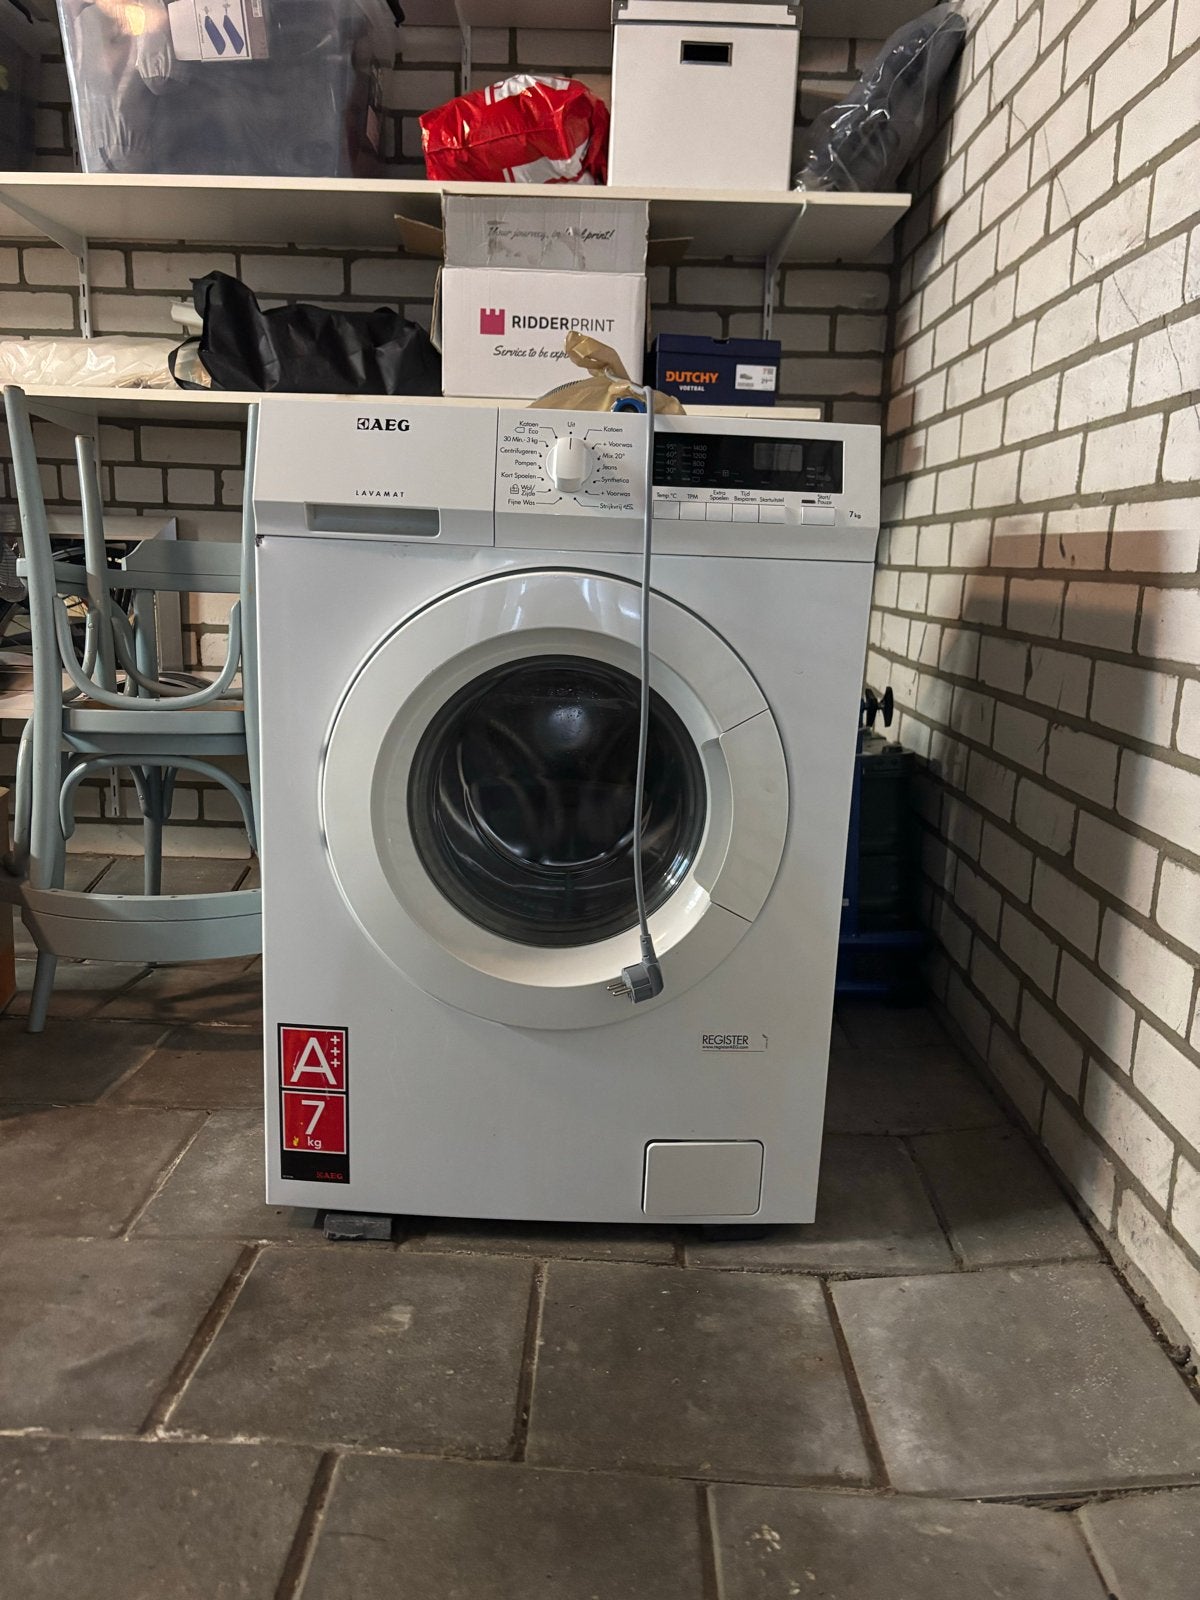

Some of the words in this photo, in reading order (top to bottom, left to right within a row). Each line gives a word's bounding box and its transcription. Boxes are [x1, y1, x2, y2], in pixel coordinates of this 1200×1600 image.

[512, 315, 615, 332] RIDDERPRINT
[493, 345, 528, 357] Service
[528, 348, 537, 357] to
[538, 347, 549, 358] be
[665, 371, 719, 384] DUTCHY
[370, 418, 411, 432] AEG
[528, 427, 539, 435] Eco
[531, 437, 539, 445] kg
[608, 440, 633, 448] Voorwas
[500, 446, 538, 456] Centrifugeren
[514, 459, 538, 467] Pompen
[602, 463, 618, 471] Jeans
[513, 472, 537, 480] Spoelen
[600, 476, 630, 484] Synthetica
[355, 490, 404, 498] LAVAMAT
[606, 490, 631, 498] Voorwas
[848, 510, 854, 518] 7
[702, 1034, 749, 1045] REGISTER
[301, 1099, 326, 1135] 7
[307, 1136, 322, 1149] kg
